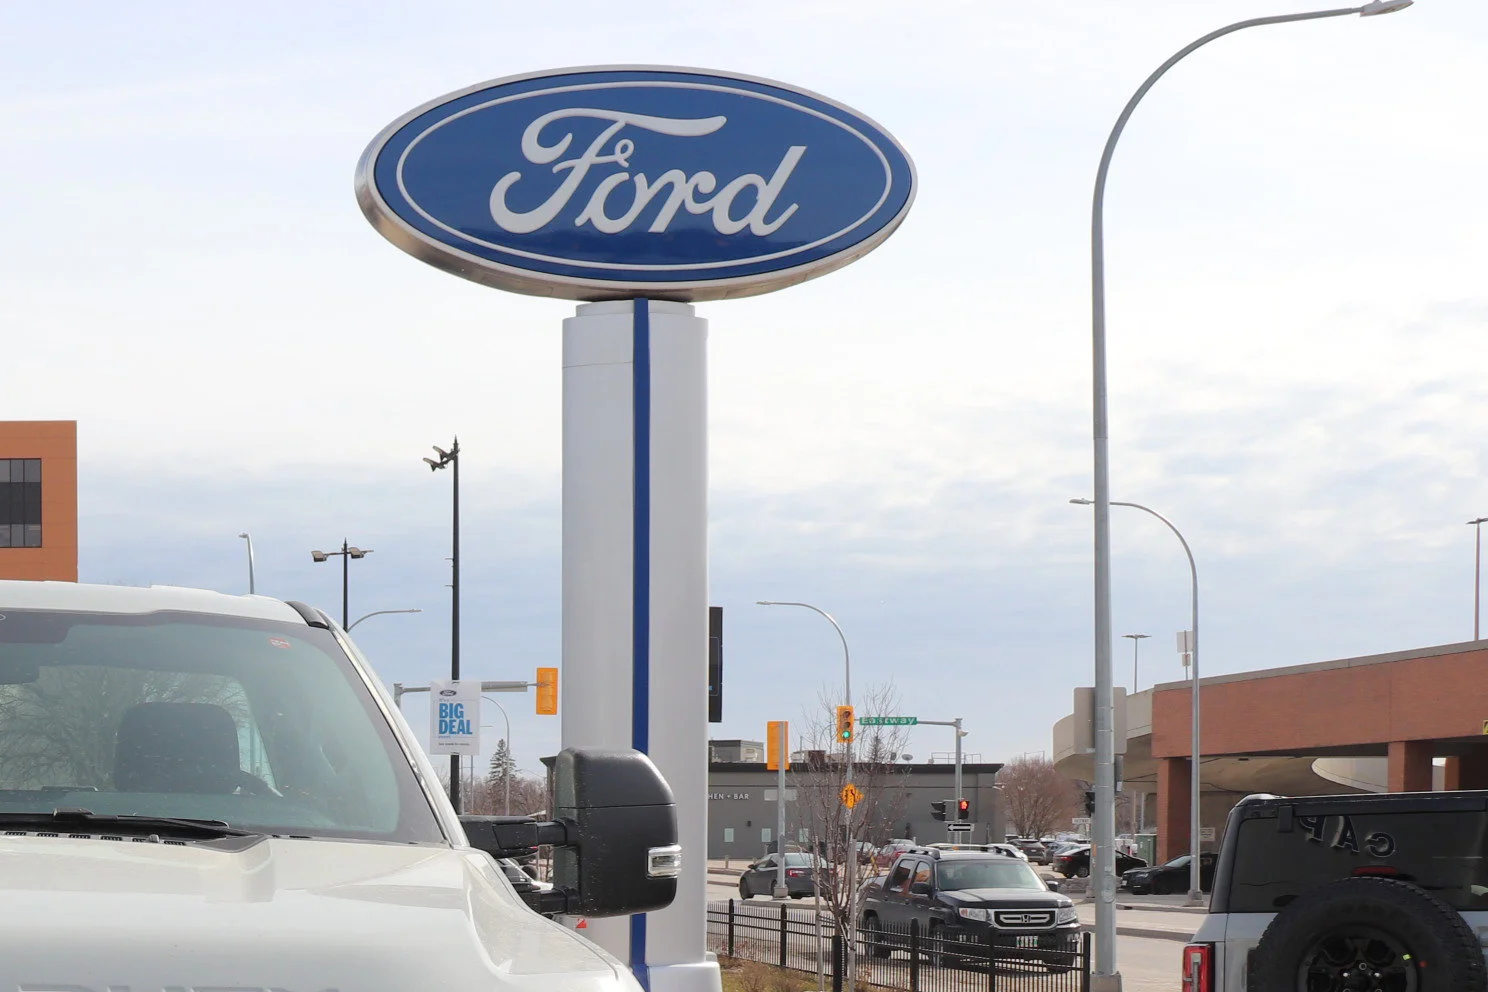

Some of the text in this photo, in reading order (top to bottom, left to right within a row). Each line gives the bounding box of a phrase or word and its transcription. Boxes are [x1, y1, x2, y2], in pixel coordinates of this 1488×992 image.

[490, 108, 807, 236] Ford
[439, 703, 464, 718] BIG
[439, 720, 473, 734] DEAL
[862, 717, 915, 725] Eastway
